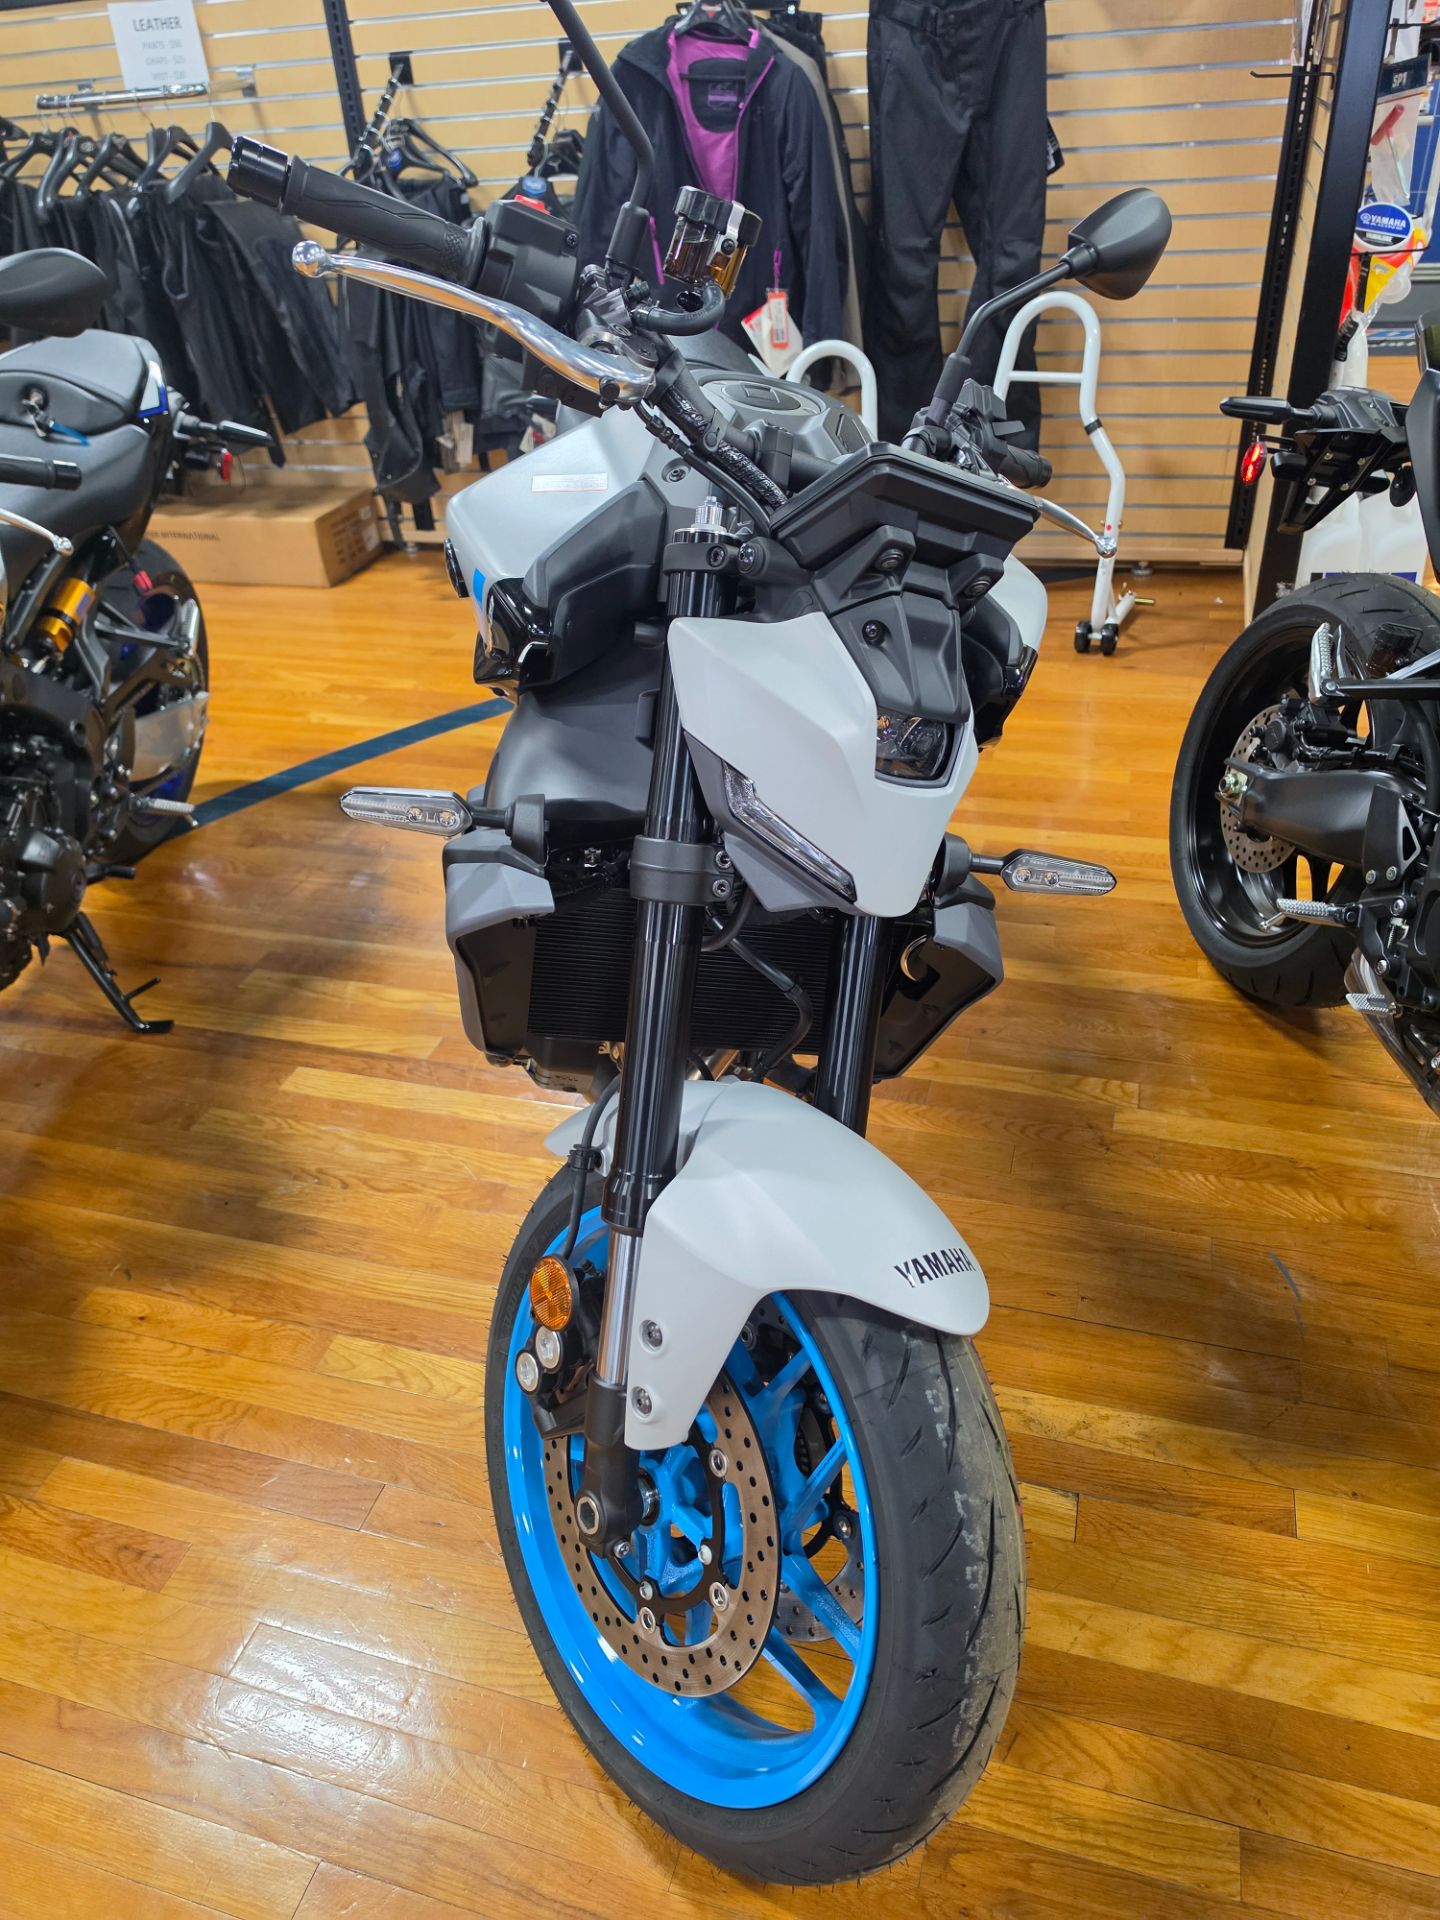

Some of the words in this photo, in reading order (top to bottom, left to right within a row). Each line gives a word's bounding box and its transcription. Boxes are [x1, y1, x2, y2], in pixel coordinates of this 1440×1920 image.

[132, 16, 183, 32] LEATHER
[1371, 215, 1406, 228] YAMAHA
[894, 1247, 976, 1288] YAMAHA
